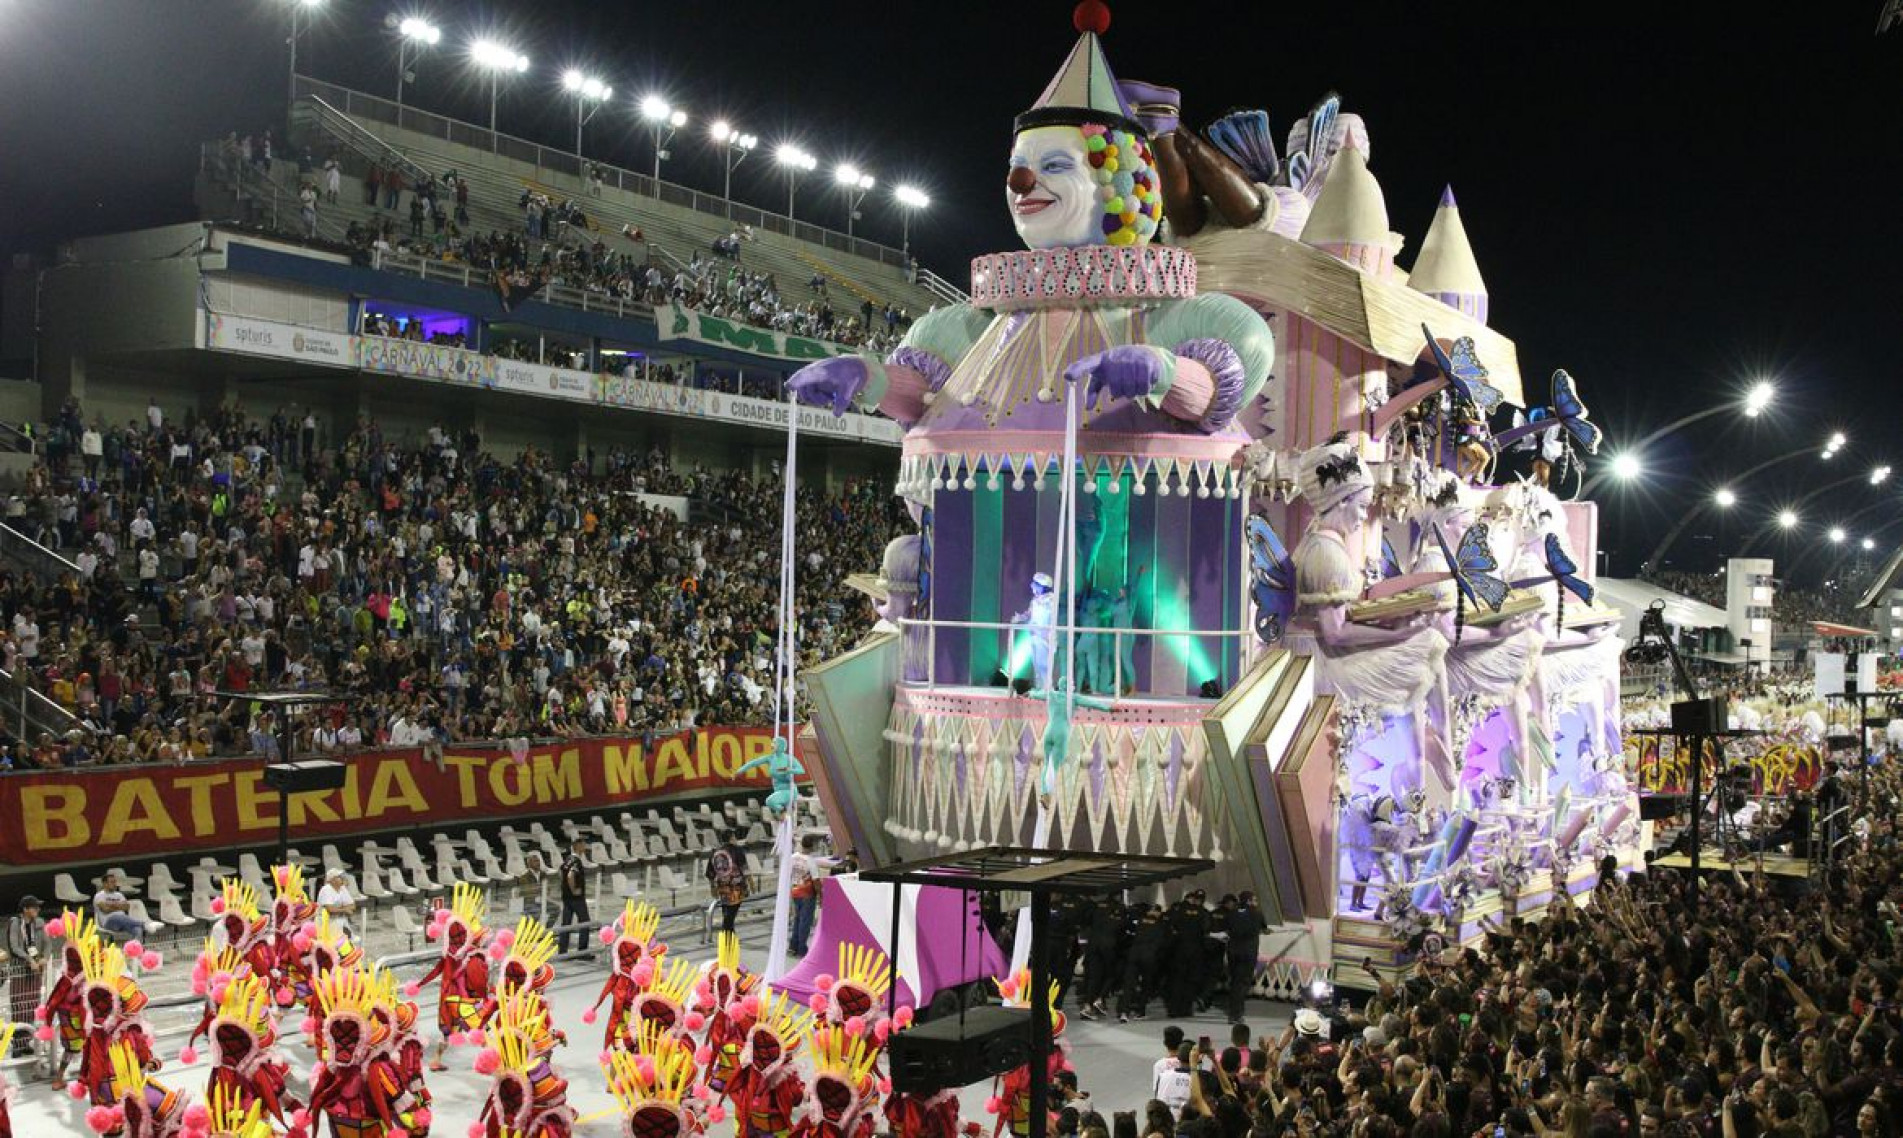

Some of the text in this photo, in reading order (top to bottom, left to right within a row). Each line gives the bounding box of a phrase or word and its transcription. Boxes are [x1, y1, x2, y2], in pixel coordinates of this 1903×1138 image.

[235, 327, 273, 345] spturis
[370, 346, 442, 373] CARNAVAL
[731, 401, 772, 422] CIDADE
[774, 407, 789, 423] DE
[815, 413, 847, 432] PAULO
[21, 731, 772, 851] BATERIA TOM MAIOR
